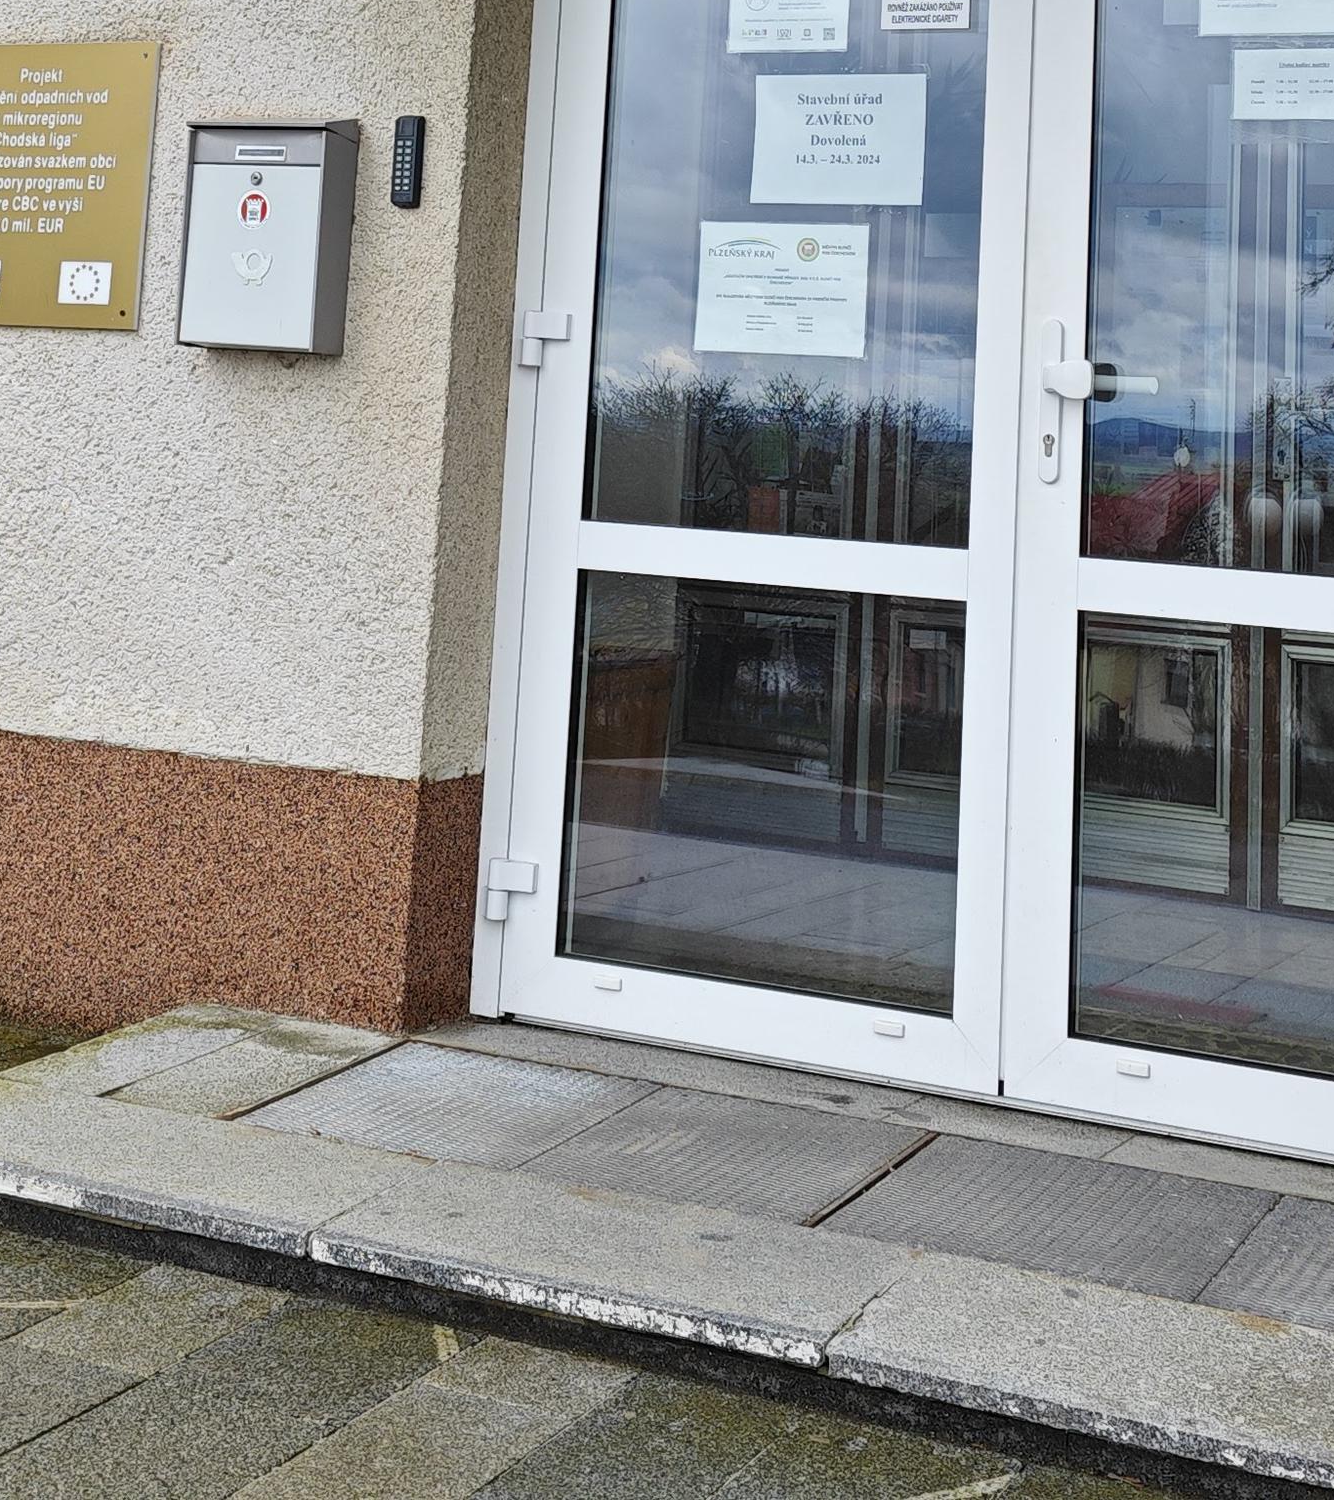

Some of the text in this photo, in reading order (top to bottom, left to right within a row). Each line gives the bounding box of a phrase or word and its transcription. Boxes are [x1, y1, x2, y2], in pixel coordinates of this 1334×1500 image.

[909, 2, 937, 12] ZAKÁZÁNO
[20, 68, 63, 86] Projekt
[21, 90, 84, 107] odpadních
[86, 89, 109, 104] vod
[797, 93, 883, 105] Stavební úřad
[3, 111, 83, 129] mikroregionu
[805, 111, 874, 125] ZAVŘENO
[811, 134, 866, 146] Dovolená
[34, 154, 86, 169] svazkem
[90, 154, 116, 169] obcí
[796, 154, 818, 164] 14.3.
[829, 154, 854, 164] 24.3.
[856, 154, 881, 164] 2024
[24, 176, 84, 193] programu
[87, 175, 105, 190] EU
[12, 196, 39, 212] CBC
[42, 199, 56, 211] ve
[58, 197, 83, 215] výši
[12, 217, 33, 233] mil.
[37, 218, 64, 233] EUR
[708, 247, 775, 260] PLZEŇSKÝ KRAJ
